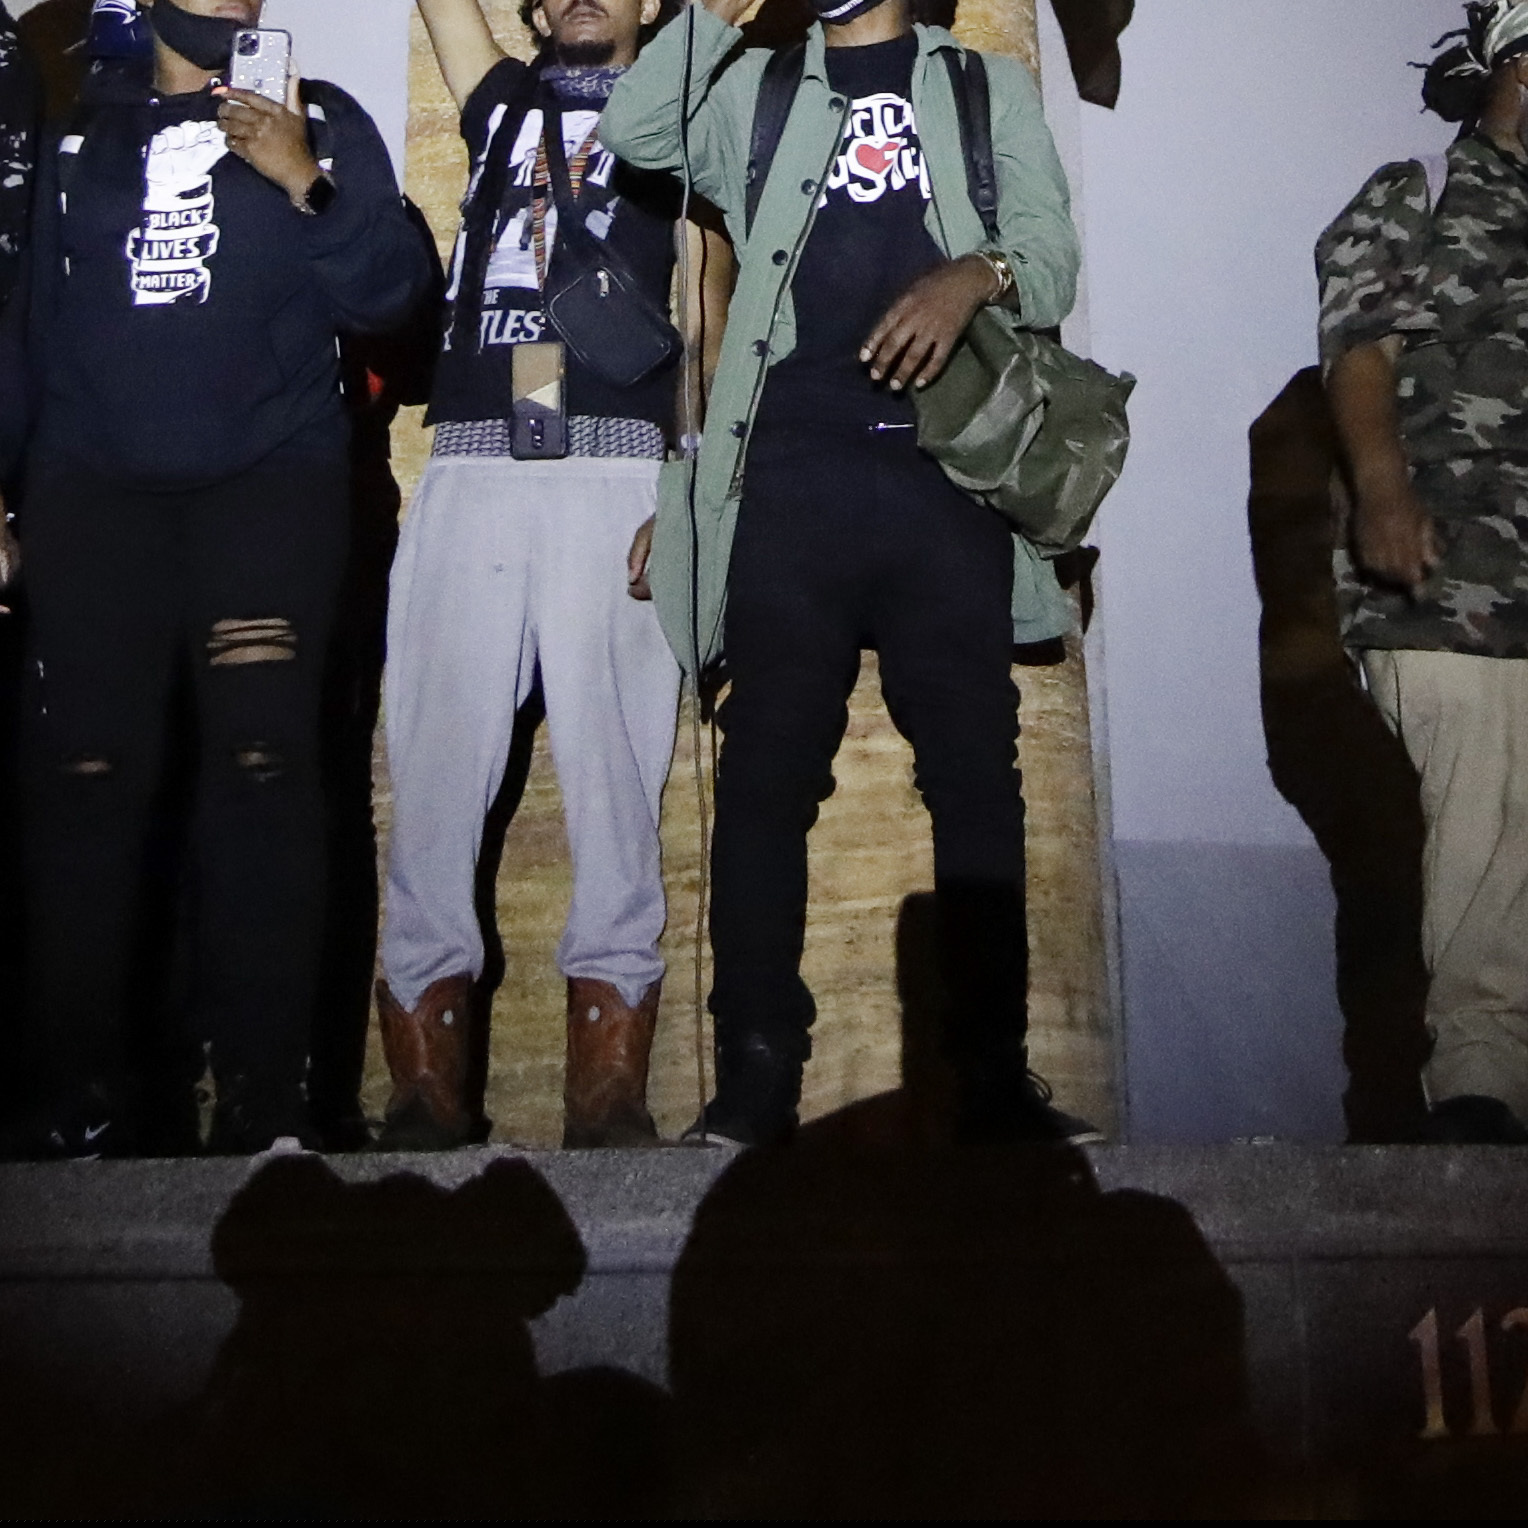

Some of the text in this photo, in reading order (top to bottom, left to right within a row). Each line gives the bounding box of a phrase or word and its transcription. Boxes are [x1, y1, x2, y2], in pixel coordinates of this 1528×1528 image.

[148, 209, 203, 229] BLACK
[141, 237, 201, 260] LIVES
[138, 273, 196, 289] MATTER
[482, 288, 501, 306] THE
[476, 309, 542, 354] TLES
